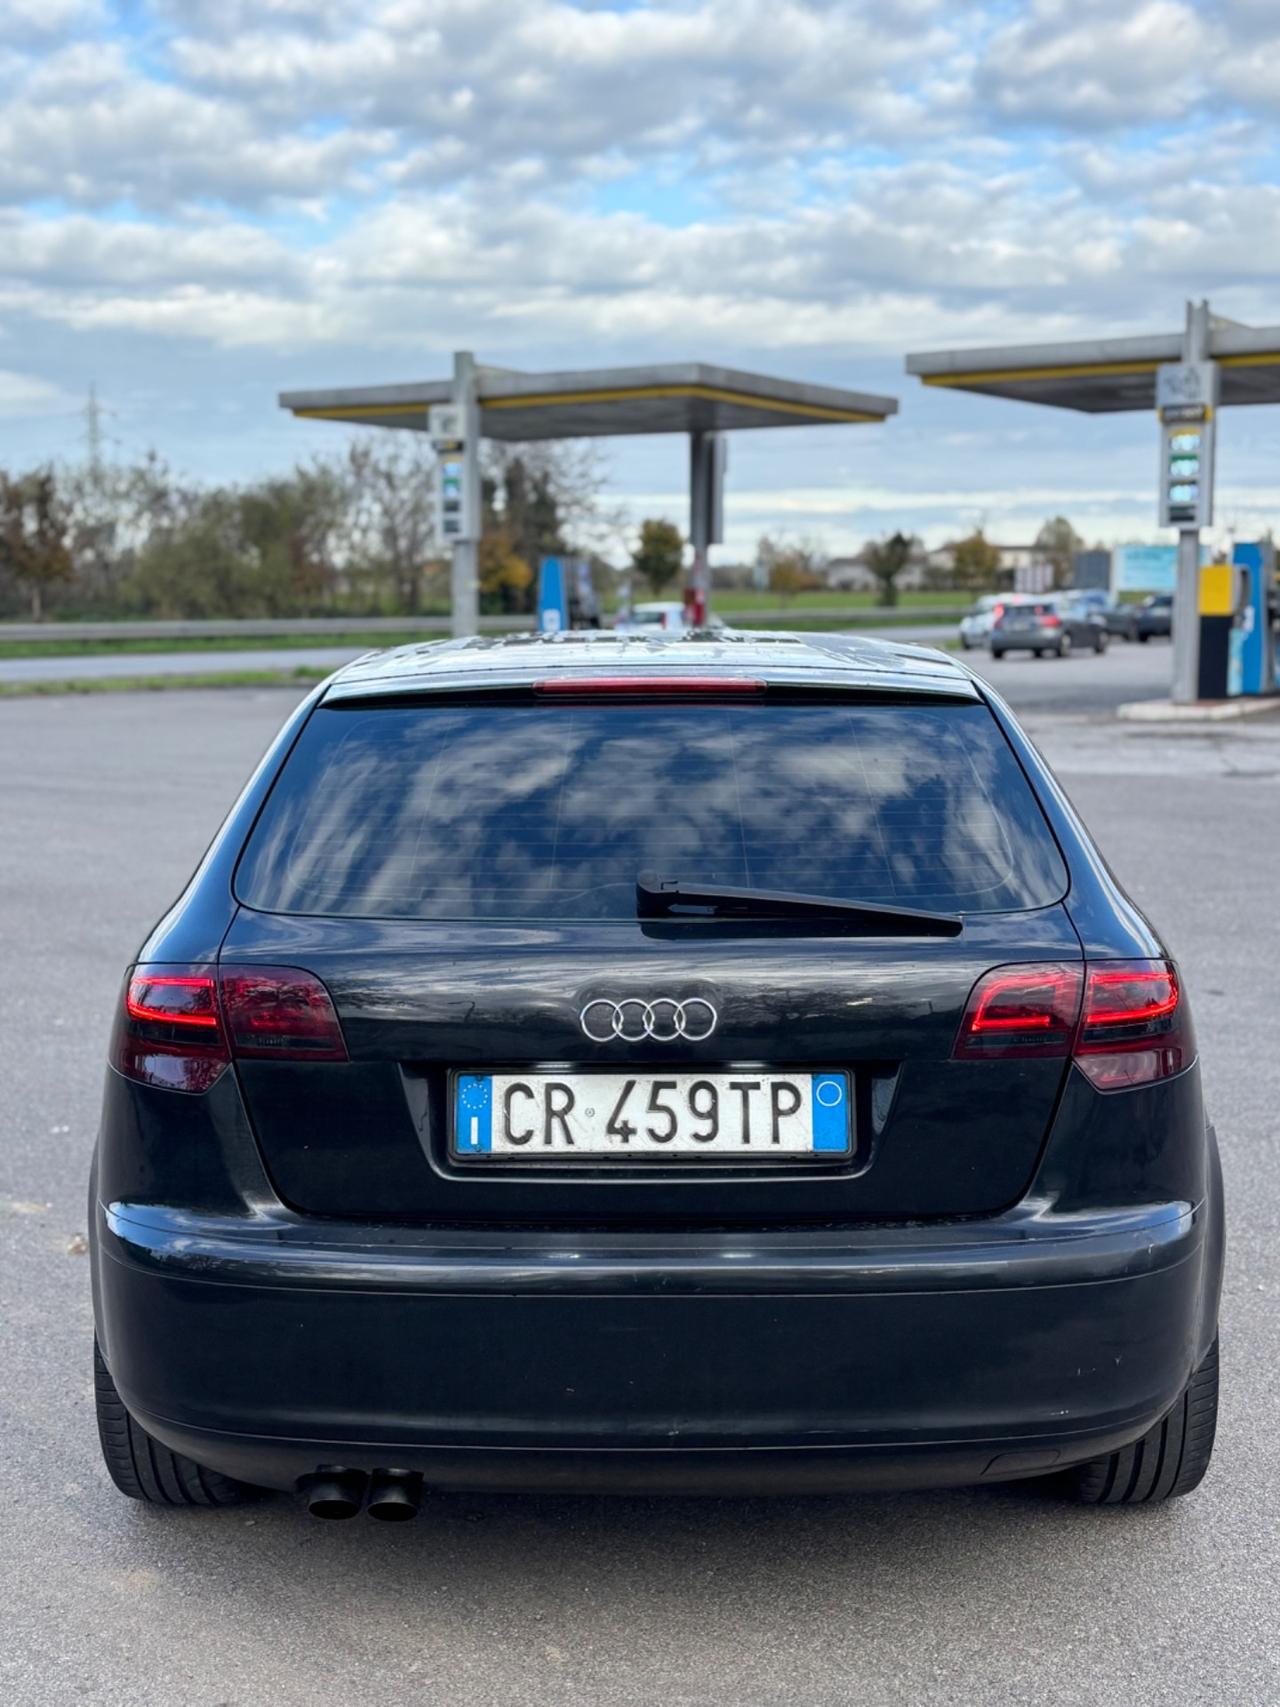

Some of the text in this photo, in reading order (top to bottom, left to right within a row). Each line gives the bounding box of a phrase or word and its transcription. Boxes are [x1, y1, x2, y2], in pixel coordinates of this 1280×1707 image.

[470, 1116, 478, 1144] I
[504, 1079, 803, 1145] CR 459TP
